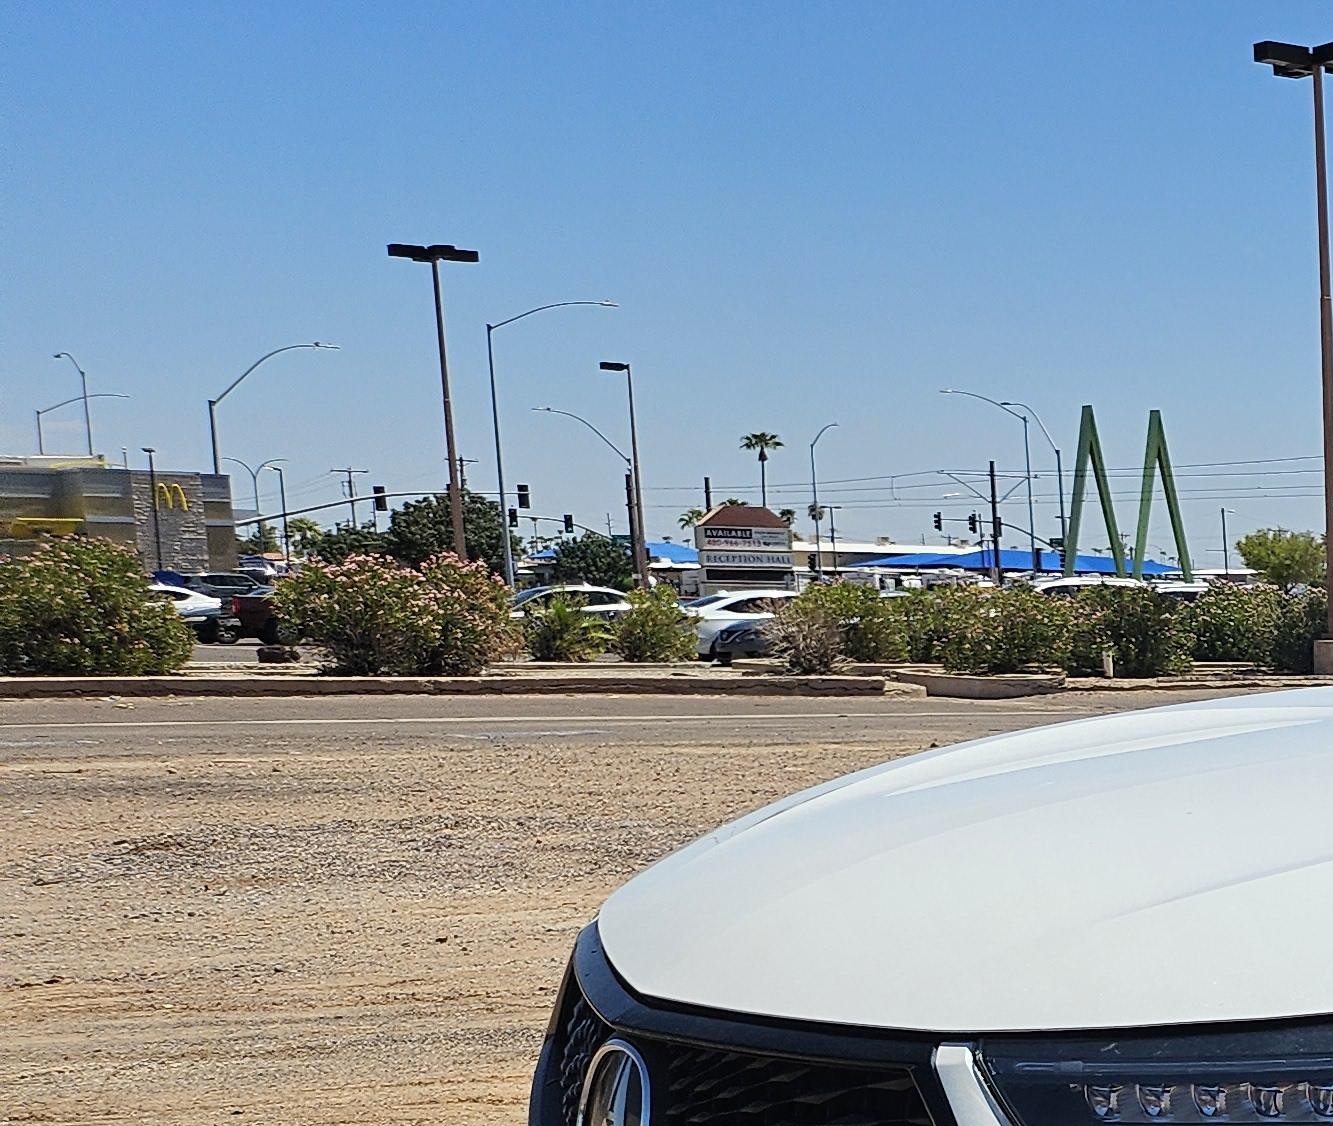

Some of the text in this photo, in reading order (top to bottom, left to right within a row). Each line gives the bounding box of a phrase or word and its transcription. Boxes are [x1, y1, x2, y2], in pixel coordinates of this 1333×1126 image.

[706, 529, 751, 538] AVAILABLE
[706, 554, 791, 564] RECEPTION HALL
